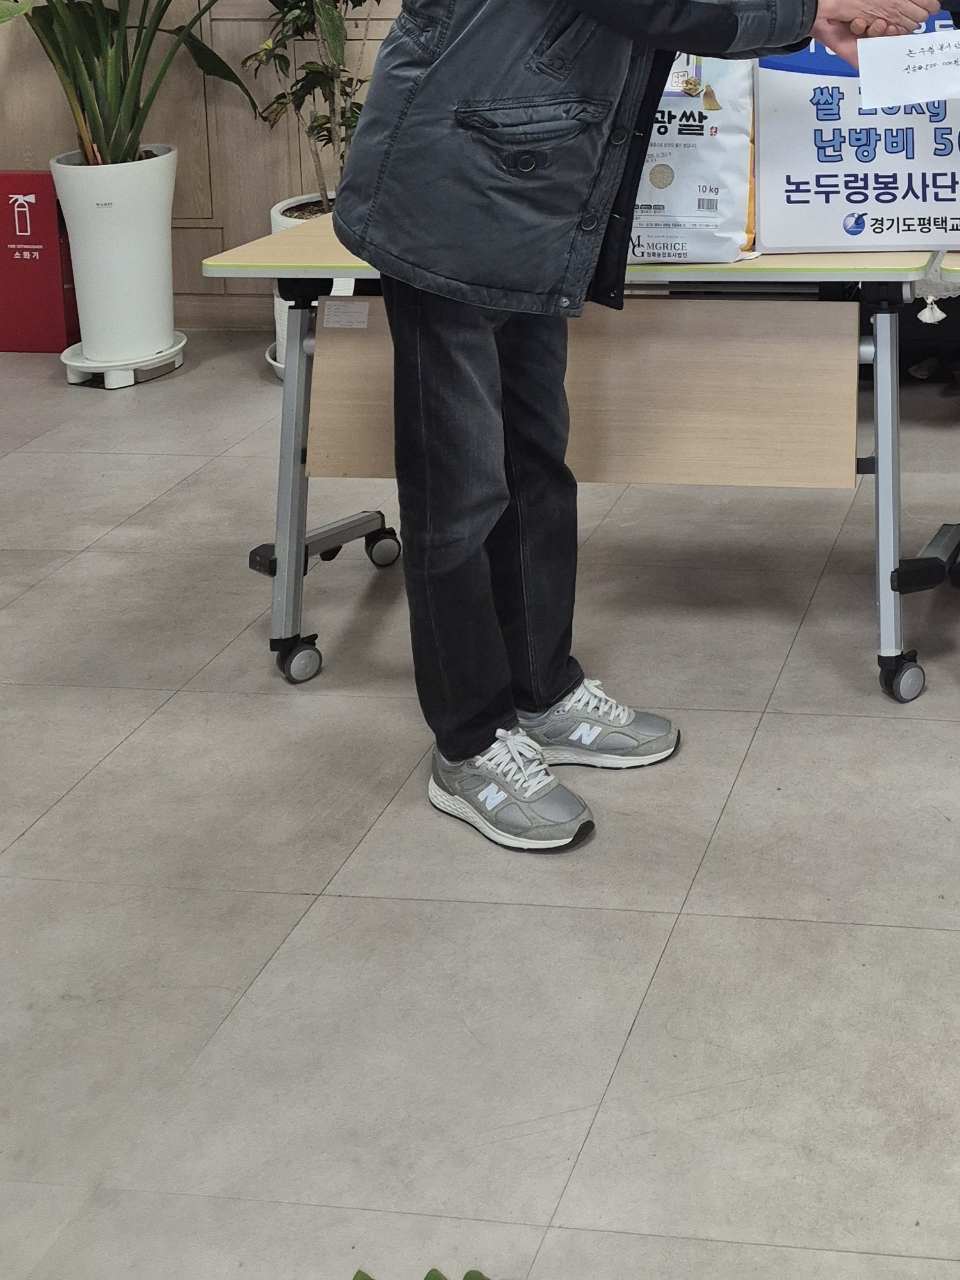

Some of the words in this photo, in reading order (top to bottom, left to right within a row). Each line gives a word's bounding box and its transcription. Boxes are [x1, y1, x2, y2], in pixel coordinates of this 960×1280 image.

[809, 86, 845, 121] 쌀
[813, 127, 915, 163] 난방비
[697, 184, 707, 194] 10
[709, 185, 719, 195] kg
[784, 172, 959, 205] 논두렁봉사단
[13, 251, 40, 260] 소화기
[646, 242, 688, 251] MGRICE
[568, 722, 602, 745] N
[477, 782, 508, 811] N
